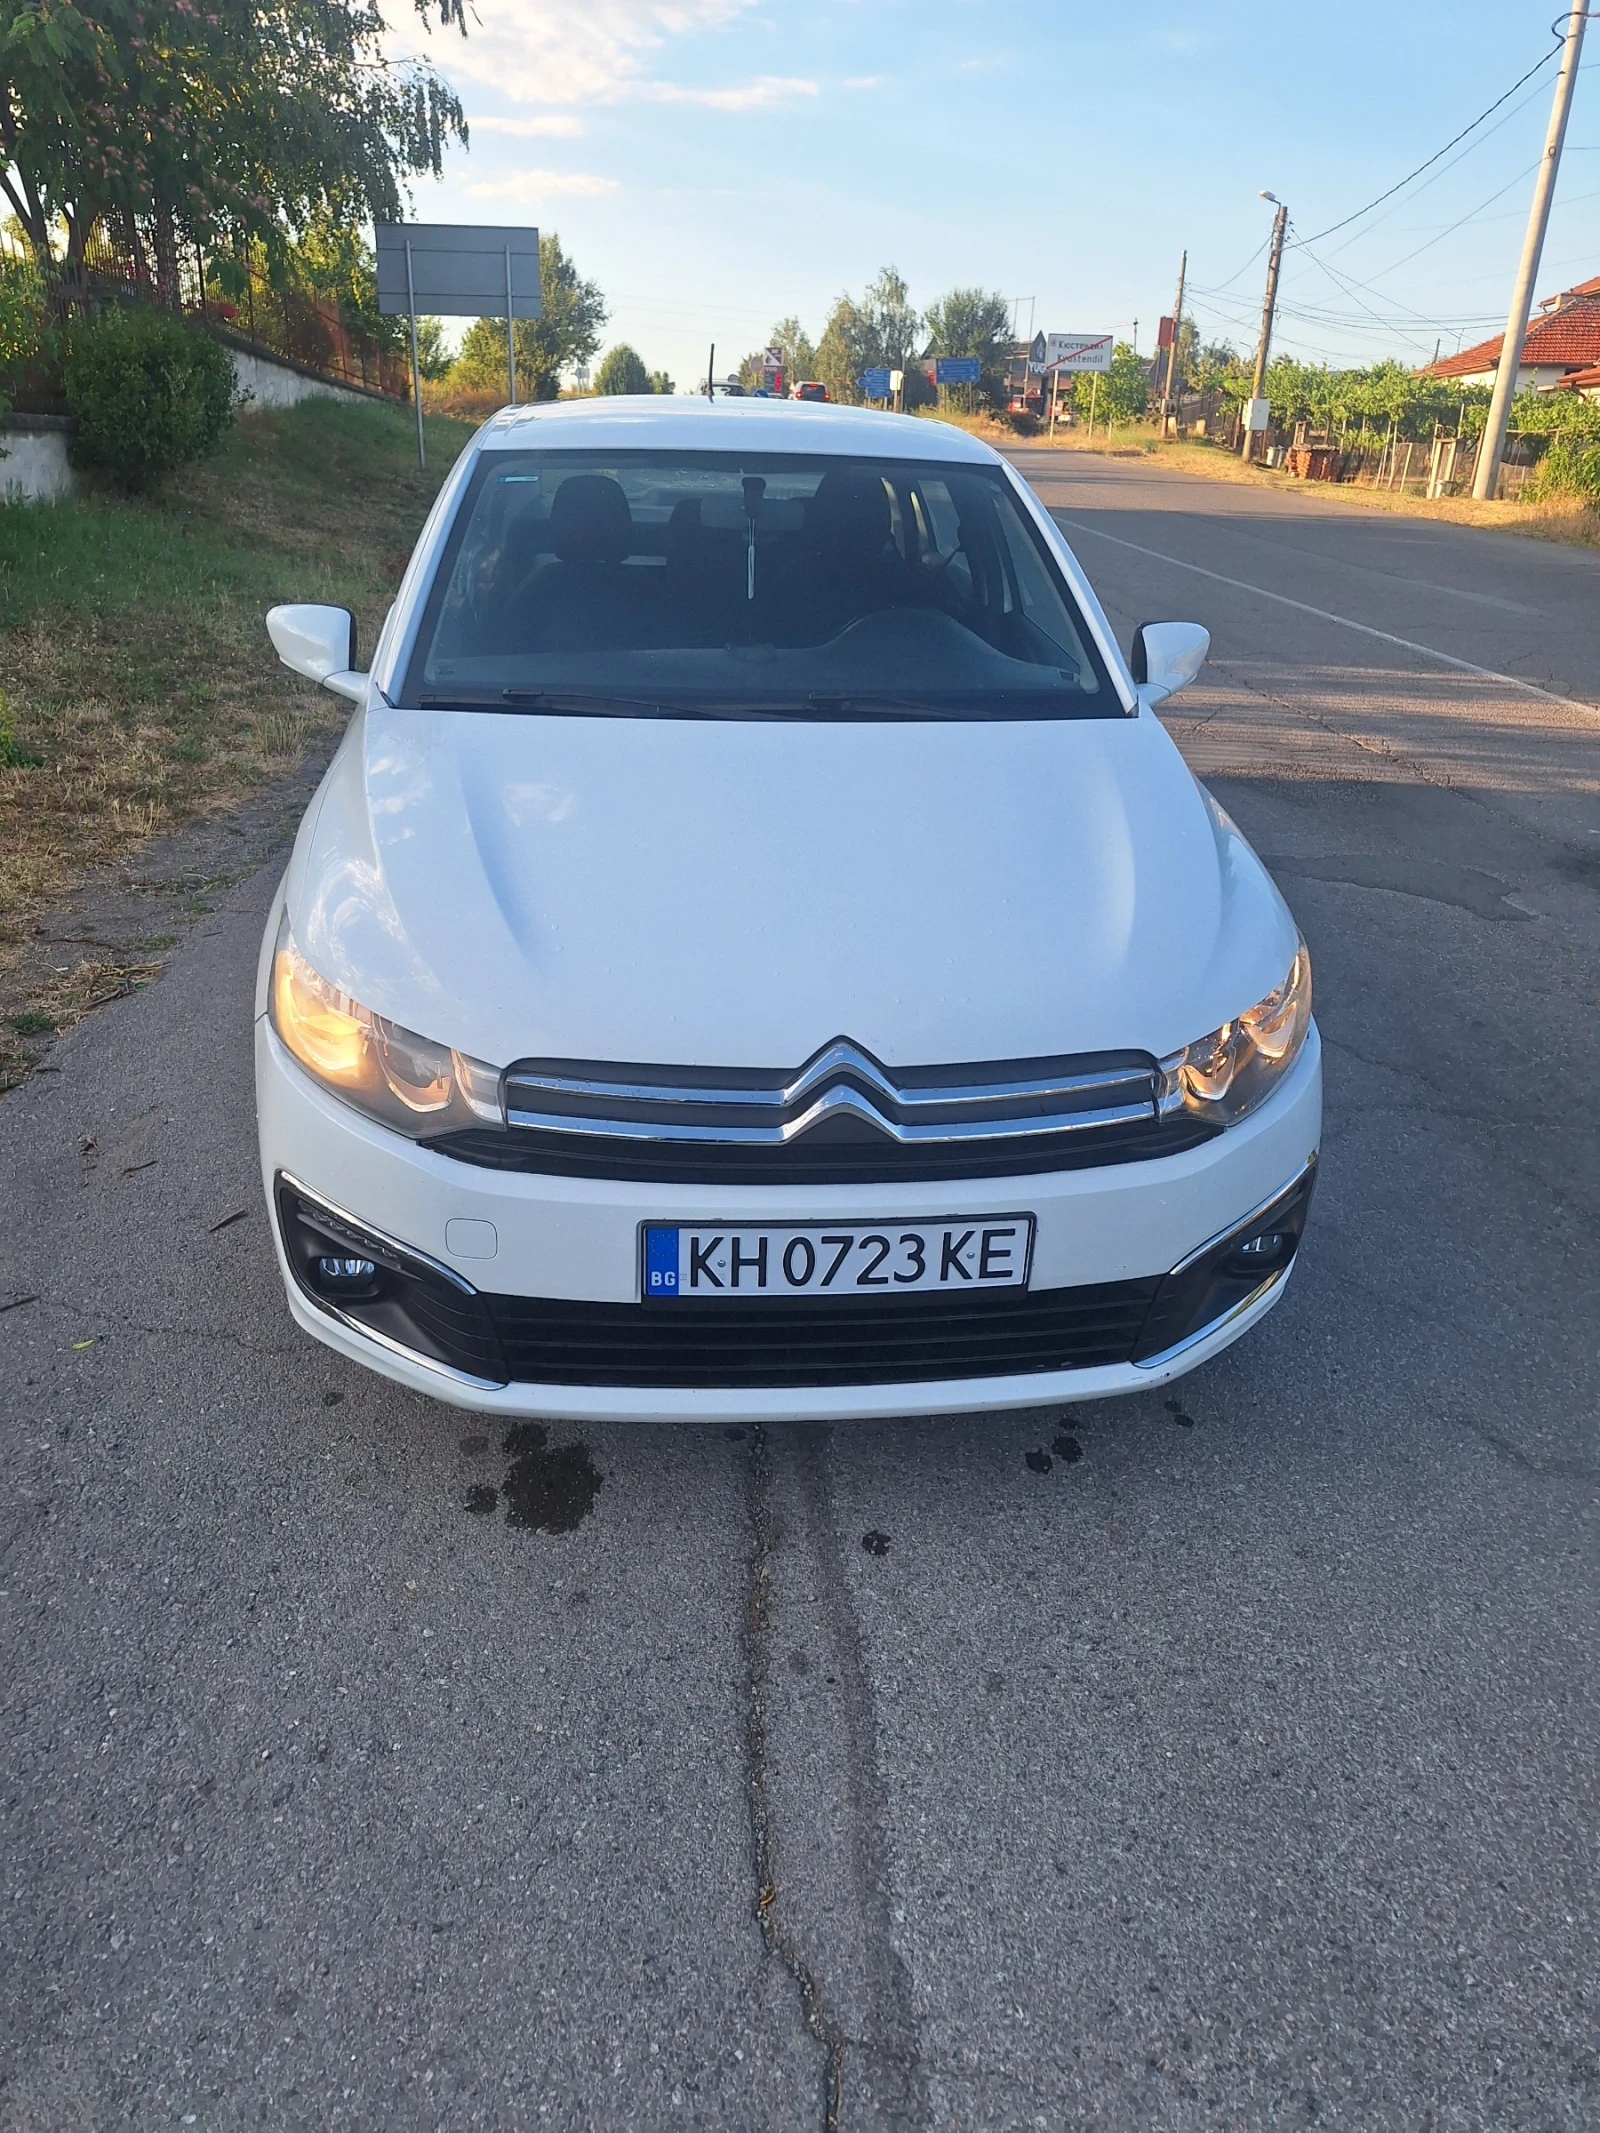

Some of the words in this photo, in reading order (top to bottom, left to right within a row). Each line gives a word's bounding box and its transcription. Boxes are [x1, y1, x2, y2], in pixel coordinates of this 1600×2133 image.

[1029, 361, 1046, 373] YUG
[782, 1233, 926, 1287] 0723
[651, 1271, 676, 1287] BG
